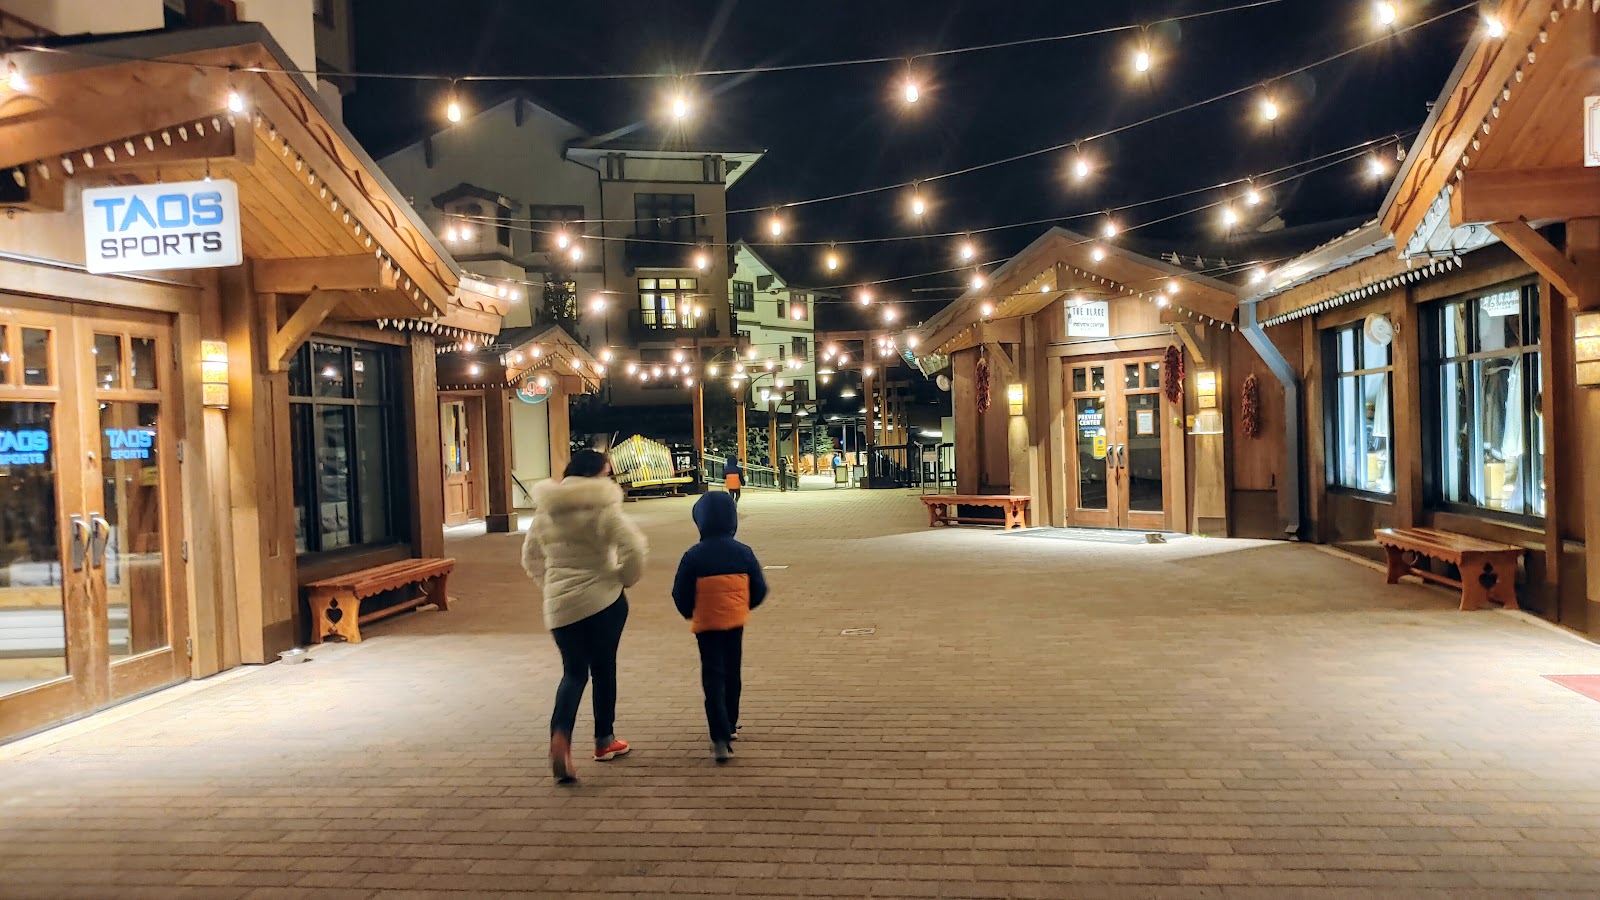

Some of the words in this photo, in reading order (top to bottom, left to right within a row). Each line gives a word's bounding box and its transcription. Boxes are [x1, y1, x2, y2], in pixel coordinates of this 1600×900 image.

[93, 191, 224, 232] TAOS
[101, 231, 222, 259] SPORTS
[1072, 307, 1083, 316] THE
[1086, 307, 1104, 317] BLAKE
[1077, 413, 1102, 421] PREVIEW
[105, 428, 152, 448] TAOS
[110, 449, 149, 460] SPORTS
